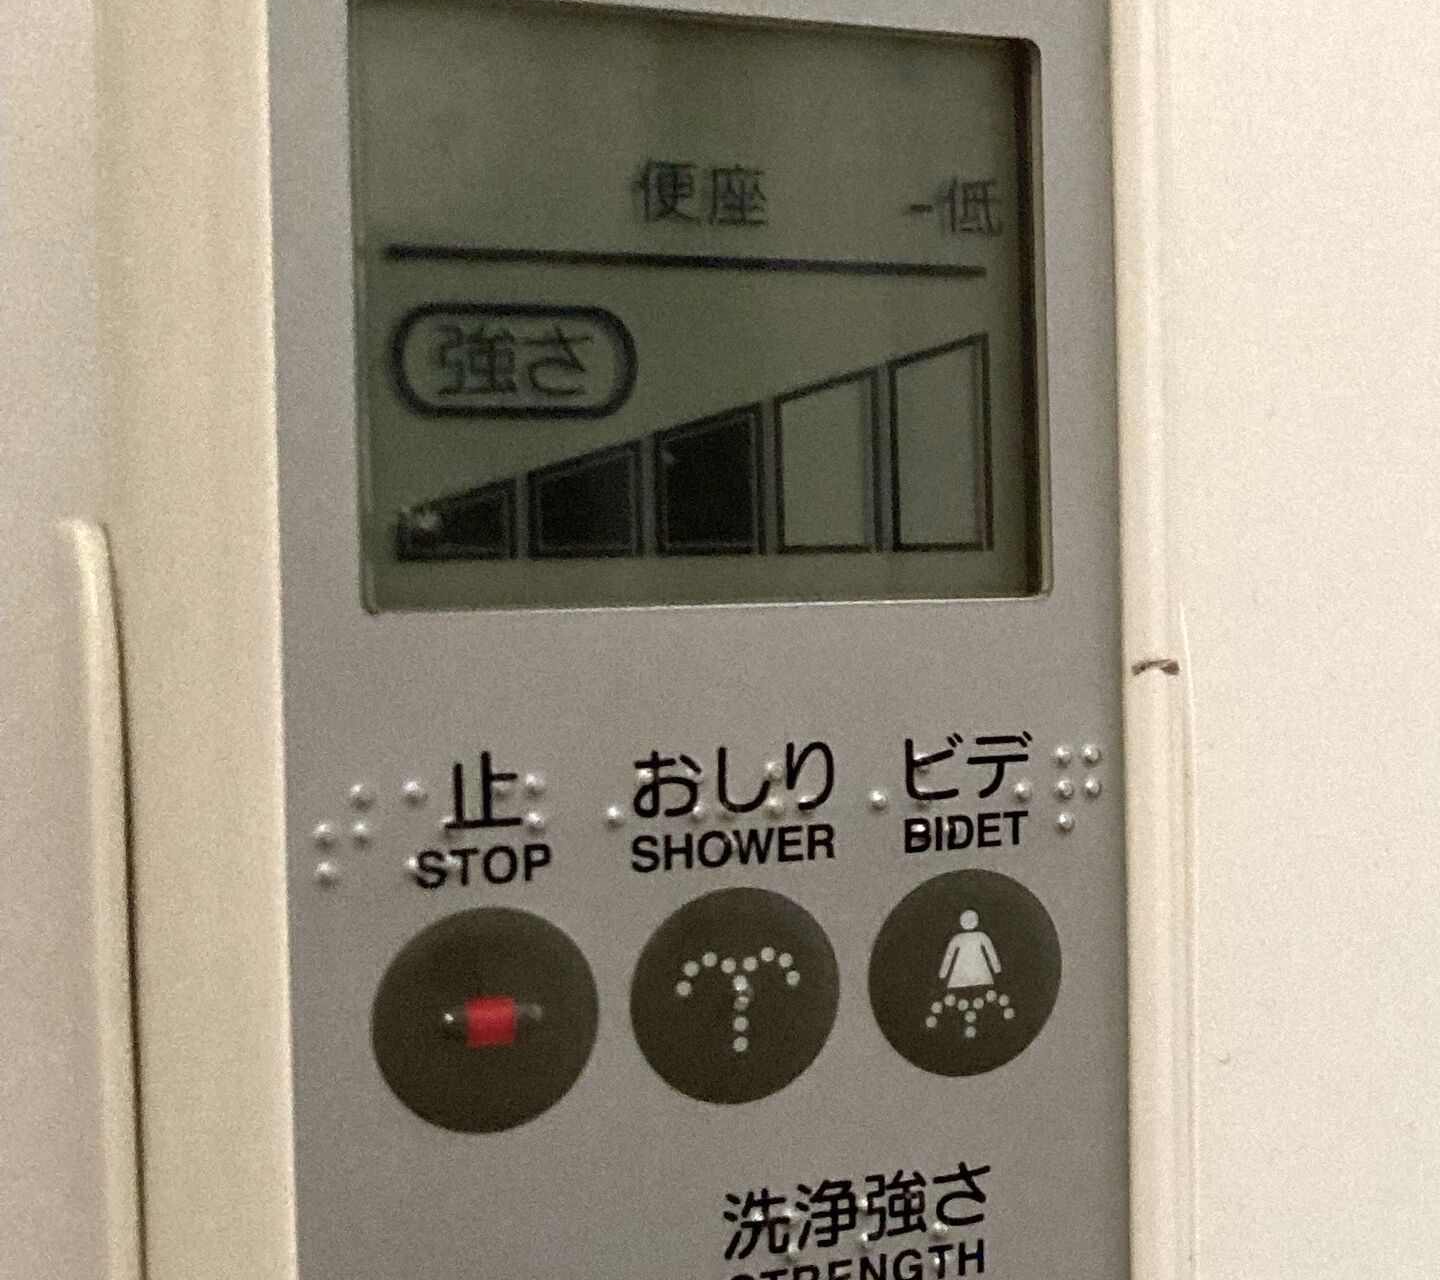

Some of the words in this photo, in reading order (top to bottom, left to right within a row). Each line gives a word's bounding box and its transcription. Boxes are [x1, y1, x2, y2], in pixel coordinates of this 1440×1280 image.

[634, 160, 768, 225] 便座
[437, 321, 593, 396] 強さ
[446, 752, 522, 831] 止
[632, 740, 835, 821] おしり
[904, 733, 1032, 803] ビデ
[416, 844, 552, 890] STOP
[631, 825, 836, 873] SHOWER
[904, 811, 1029, 855] BIDET
[722, 1162, 991, 1261] 洗浄強さ
